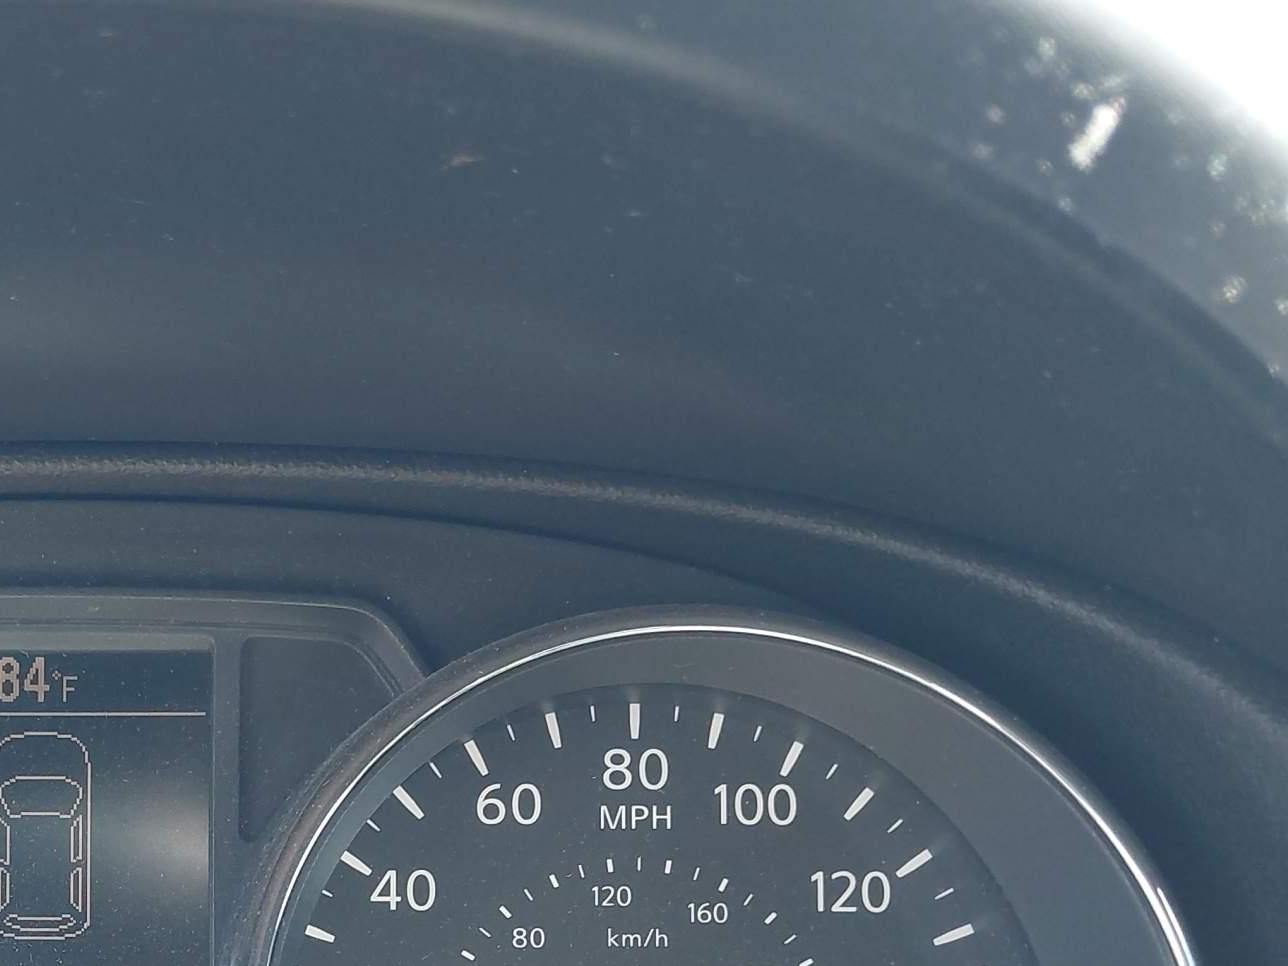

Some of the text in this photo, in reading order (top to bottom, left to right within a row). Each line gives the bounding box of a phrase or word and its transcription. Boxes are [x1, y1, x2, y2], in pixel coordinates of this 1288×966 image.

[601, 749, 669, 789] 80
[476, 784, 543, 825] 60
[599, 805, 672, 830] MPH
[714, 784, 797, 825] 100
[370, 870, 437, 910] 40
[591, 886, 632, 908] 120
[812, 872, 891, 913] 120
[688, 902, 729, 924] 160
[512, 928, 545, 949] 80
[607, 928, 669, 949] km/h
